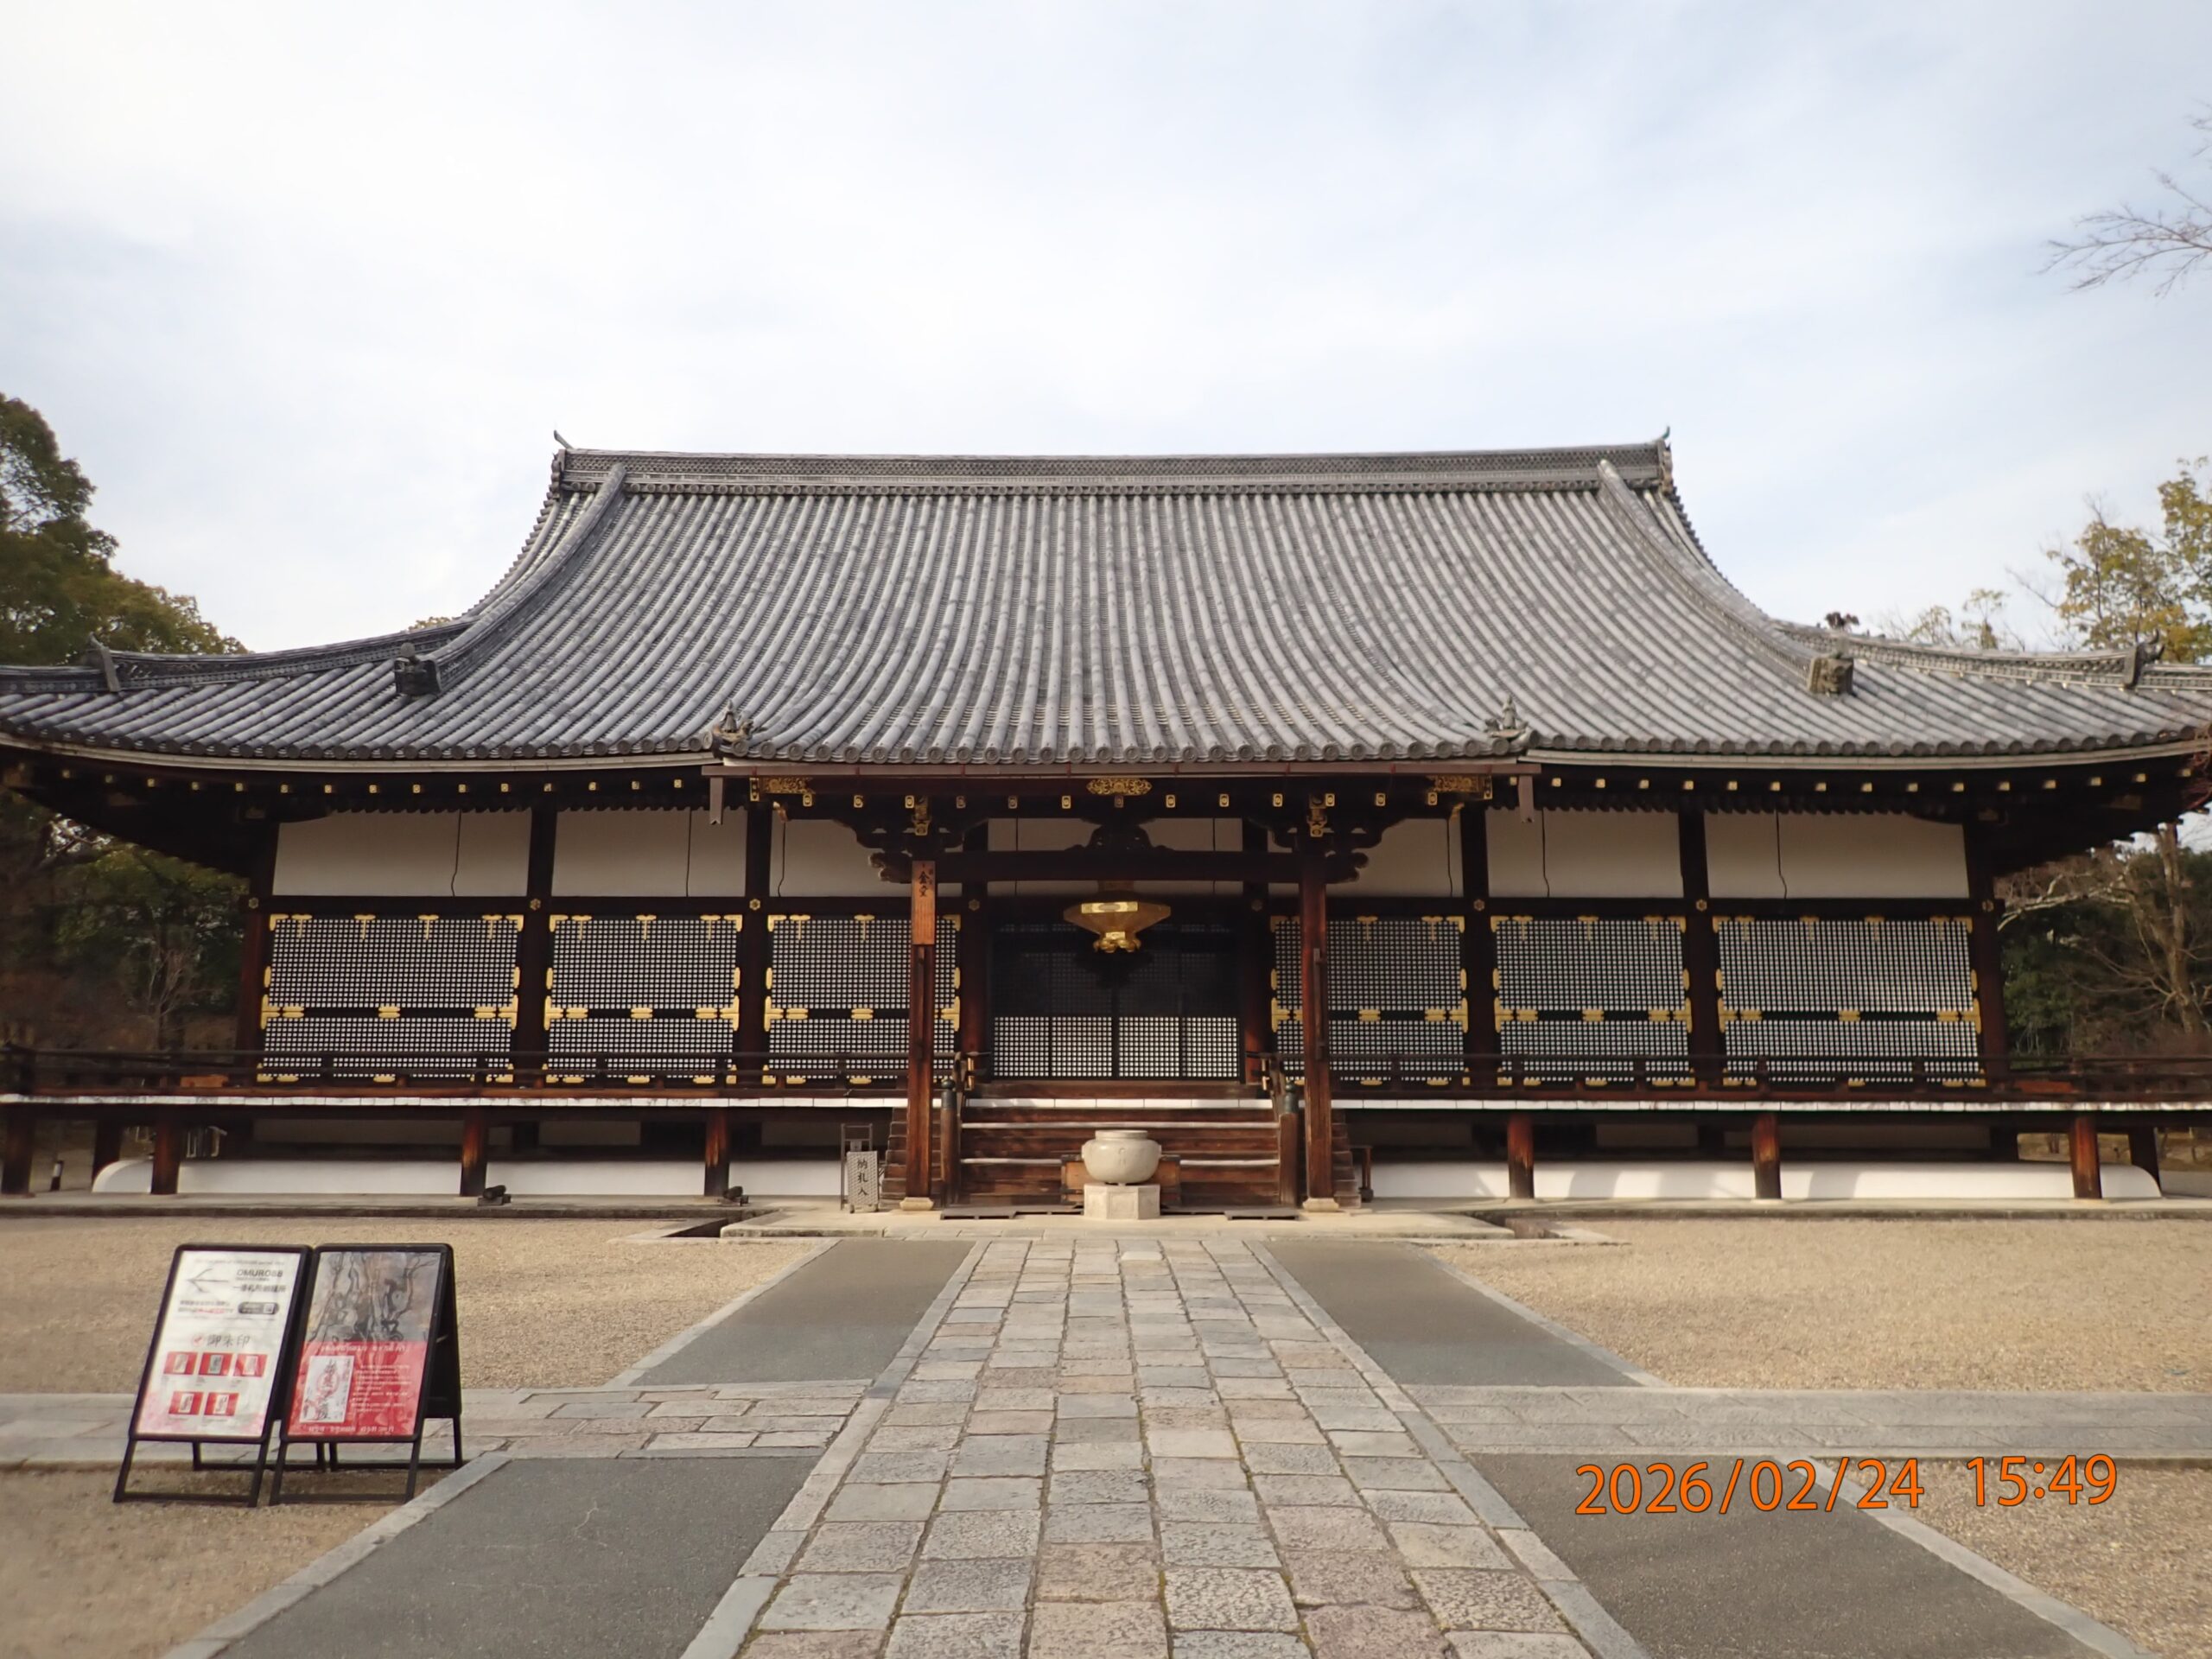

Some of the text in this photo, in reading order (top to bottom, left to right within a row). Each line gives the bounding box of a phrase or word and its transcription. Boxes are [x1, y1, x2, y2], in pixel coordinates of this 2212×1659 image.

[857, 1158, 869, 1196] 納札入
[207, 1334, 251, 1347] 御朱印
